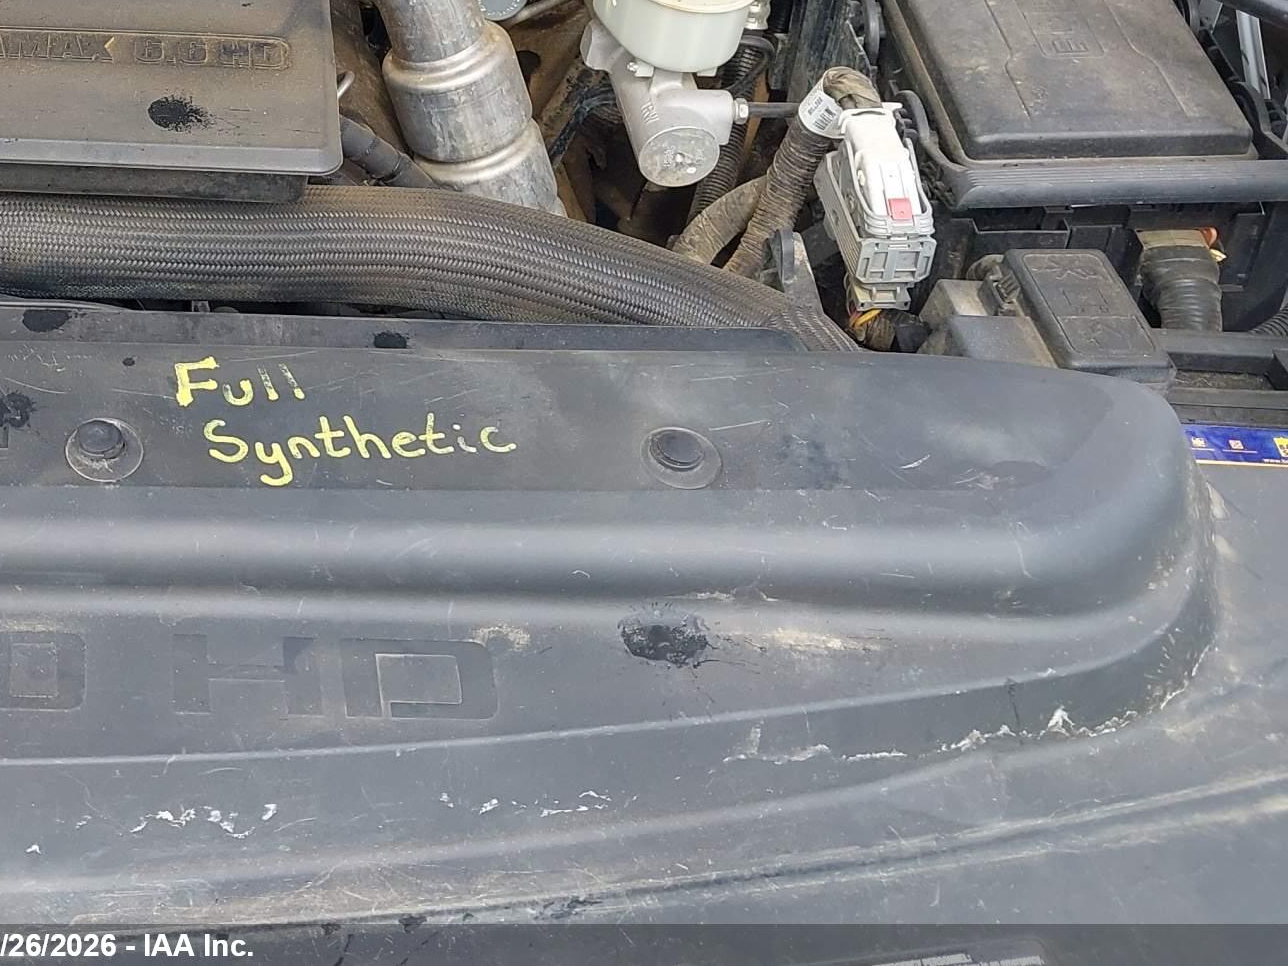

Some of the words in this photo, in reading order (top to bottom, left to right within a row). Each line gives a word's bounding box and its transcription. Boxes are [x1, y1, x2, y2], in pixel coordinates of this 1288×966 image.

[133, 36, 209, 66] 6.6
[219, 39, 289, 70] HD
[175, 356, 306, 407] Full
[203, 413, 517, 487] Synthetic
[172, 633, 501, 721] HD
